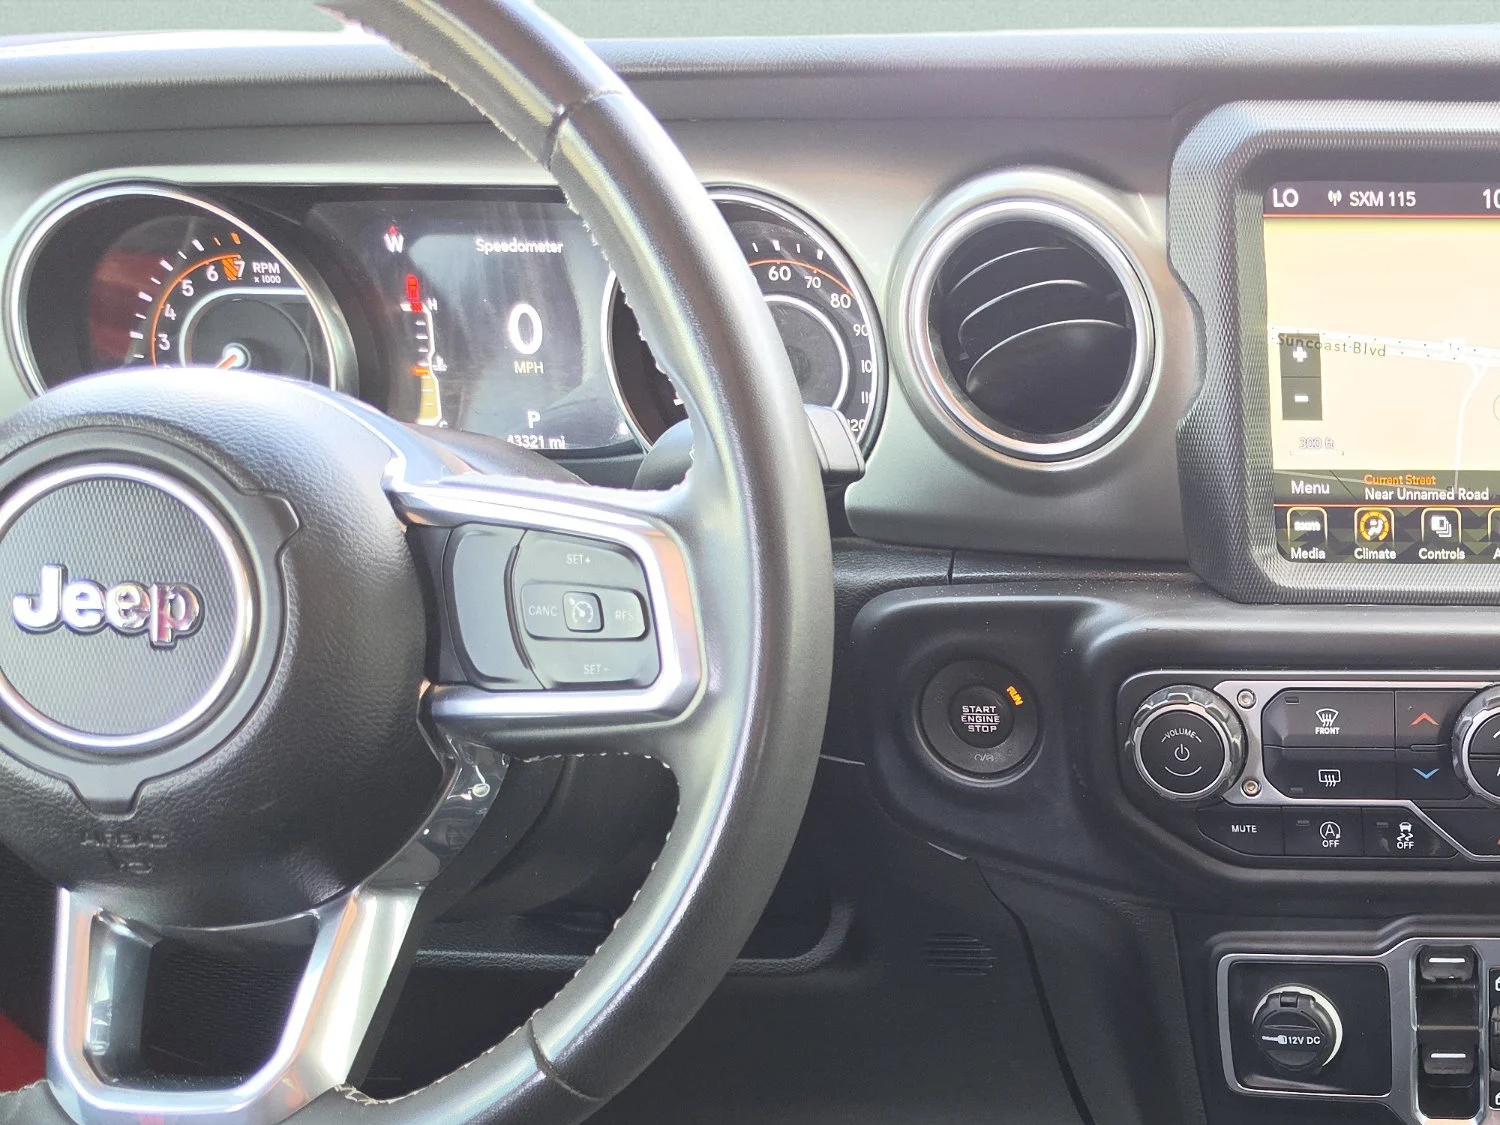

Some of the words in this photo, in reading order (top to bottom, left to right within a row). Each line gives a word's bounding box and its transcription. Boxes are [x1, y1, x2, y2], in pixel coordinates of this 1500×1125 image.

[1272, 188, 1299, 208] LO
[1349, 191, 1384, 207] SXM
[1388, 191, 1416, 207] 115
[384, 233, 404, 252] W
[475, 238, 564, 255] Speedometer
[206, 265, 219, 281] 6
[234, 260, 245, 277] 7
[252, 262, 280, 274] RPM
[768, 266, 791, 281] 60
[262, 276, 281, 284] 1000
[805, 276, 822, 289] 70
[181, 280, 194, 296] 5
[830, 293, 851, 309] 80
[164, 304, 177, 320] 4
[508, 303, 543, 355] 0
[853, 324, 869, 336] 90
[158, 334, 170, 350] 3
[1278, 333, 1347, 352] Suncoast
[1353, 341, 1386, 357] Blvd
[514, 361, 544, 374] MPH
[528, 411, 541, 428] P
[549, 435, 566, 449] mi
[1364, 474, 1402, 485] Current
[1405, 474, 1436, 485] Street
[1291, 480, 1330, 494] Menu
[1365, 488, 1394, 500] Near
[1397, 487, 1454, 500] Unnamed
[1458, 487, 1489, 500] Road
[1291, 547, 1326, 560] Media
[1354, 547, 1397, 560] Climate
[1419, 548, 1465, 560] Controls
[13, 564, 201, 644] Jeep
[528, 605, 557, 617] CANC
[1005, 685, 1024, 706] RUN
[962, 705, 996, 713] START
[961, 715, 1000, 723] ENGINE
[968, 725, 997, 733] STOP
[1165, 728, 1197, 739] VOLUME
[1315, 727, 1340, 735] FRONT
[1231, 824, 1257, 833] MUTE
[1322, 839, 1340, 848] OFF
[1396, 841, 1415, 849] OFF
[1288, 1036, 1304, 1044] 12V
[1306, 1036, 1320, 1044] DC
